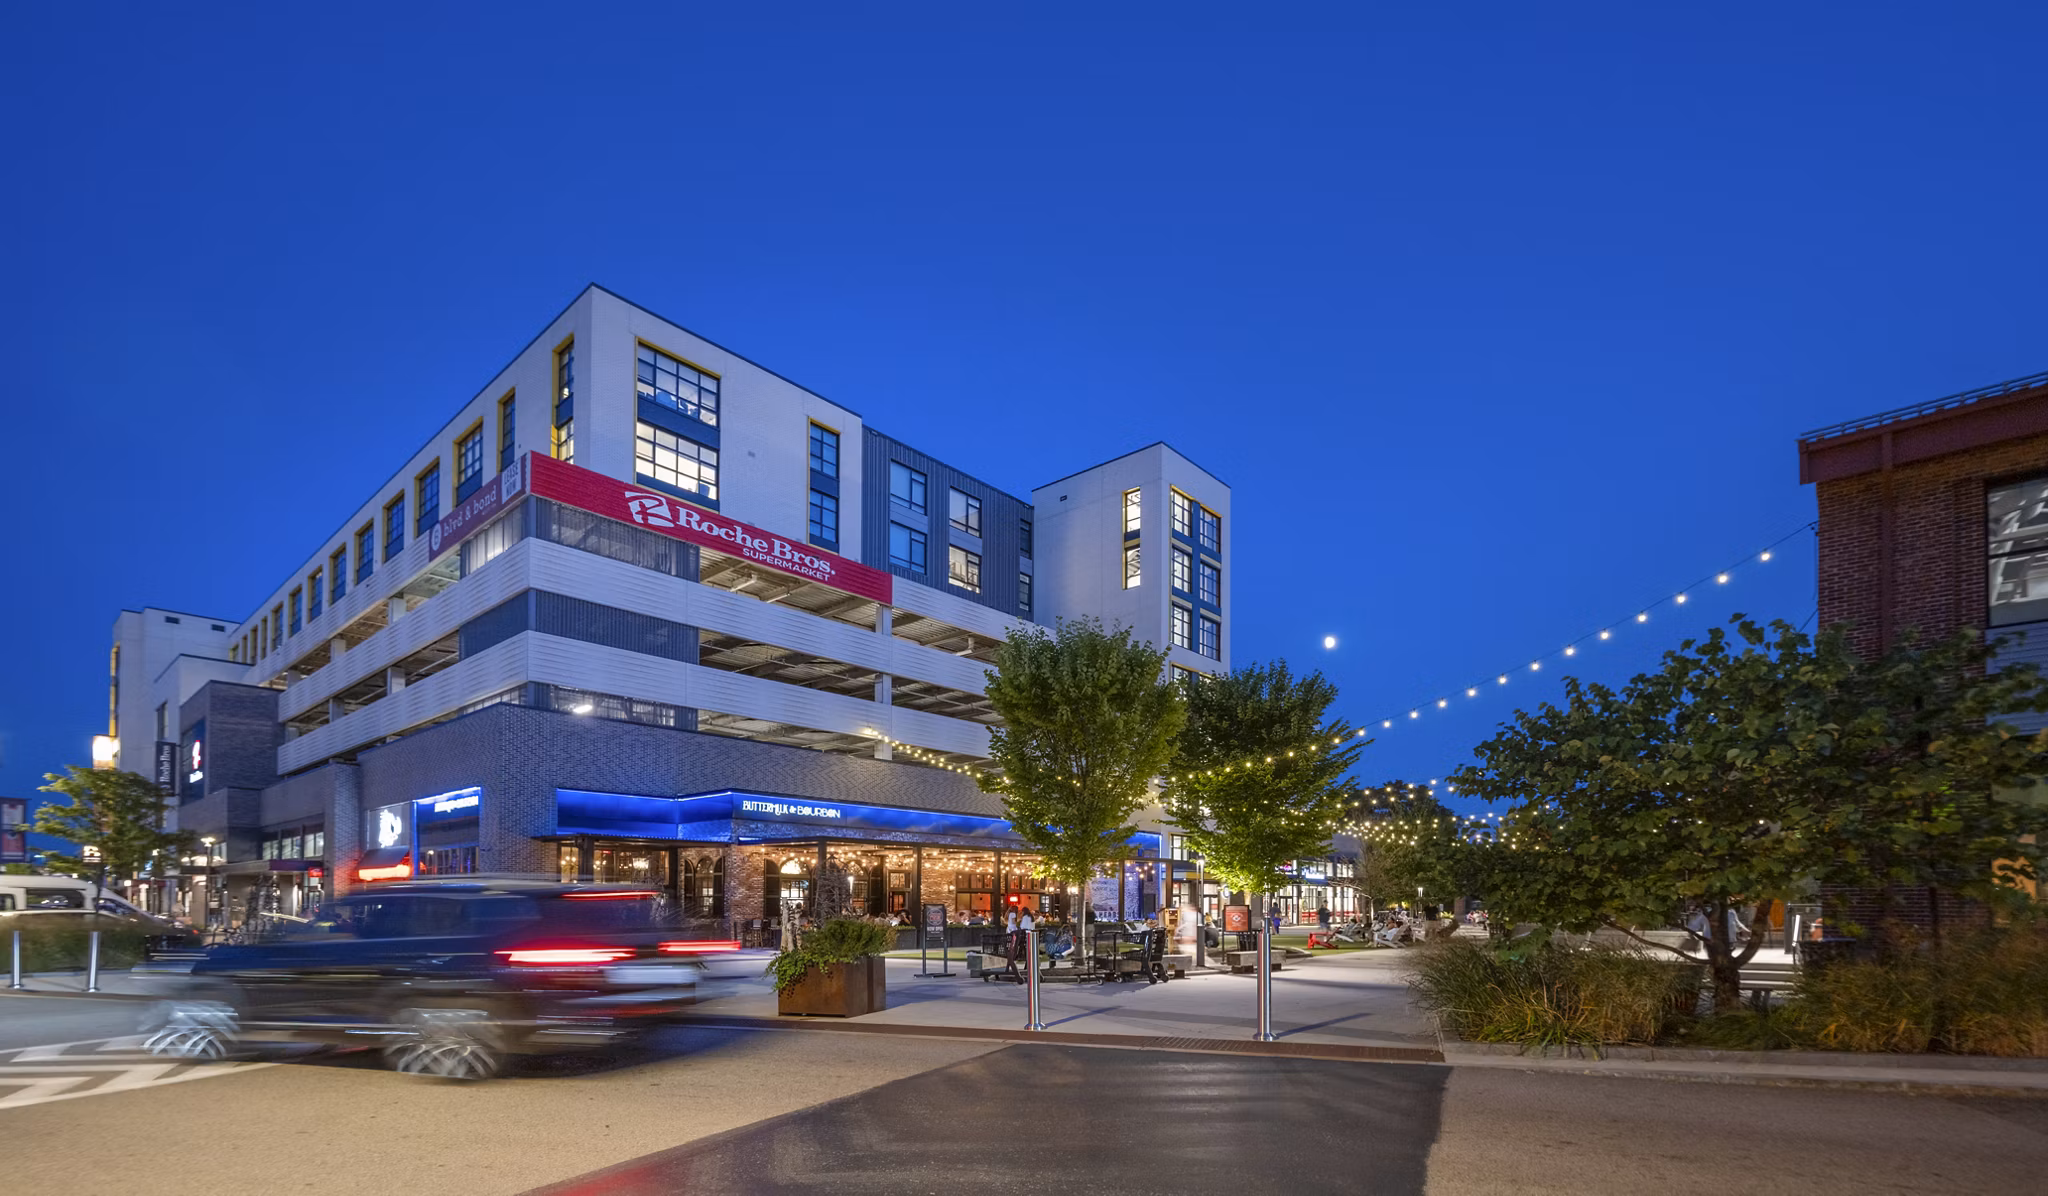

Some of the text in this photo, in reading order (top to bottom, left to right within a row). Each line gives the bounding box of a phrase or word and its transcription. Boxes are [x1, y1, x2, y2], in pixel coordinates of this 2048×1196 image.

[504, 461, 519, 485] LEASE
[506, 477, 517, 498] NOW
[443, 511, 463, 537] blvd
[473, 485, 497, 515] bond
[676, 505, 836, 576] Roche Bros.
[742, 547, 830, 582] SUPERMARKET
[742, 800, 841, 819] BUTTERMILK & BOURBON
